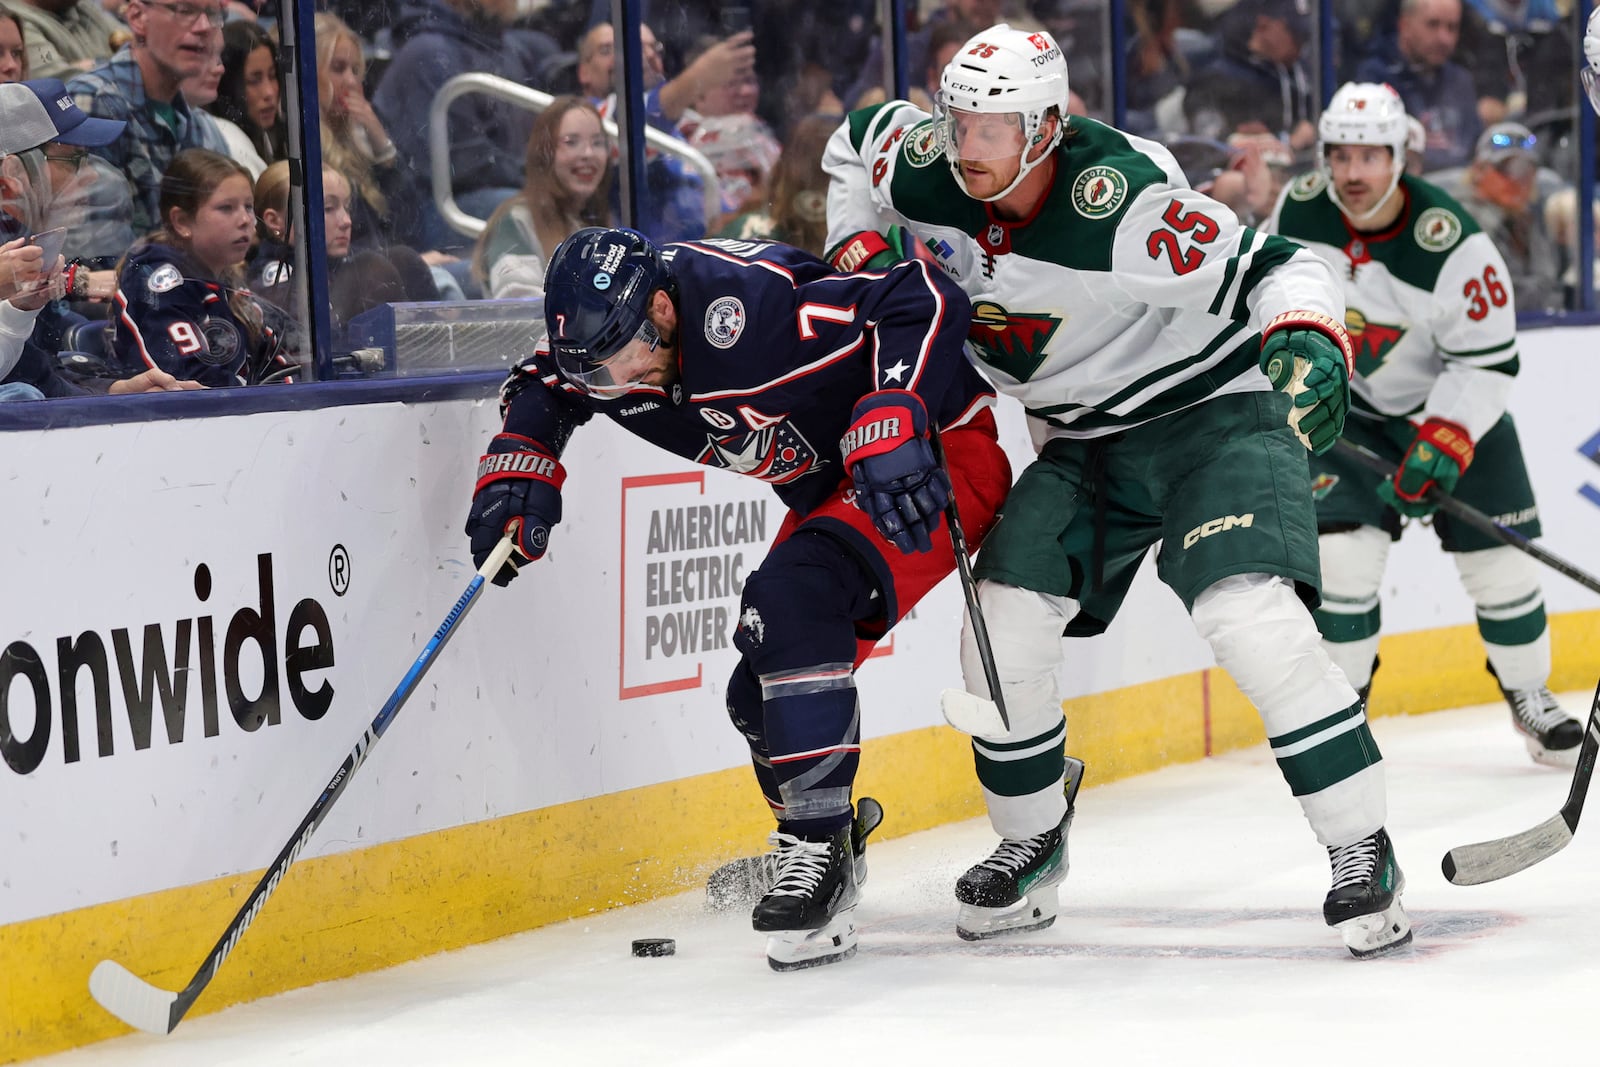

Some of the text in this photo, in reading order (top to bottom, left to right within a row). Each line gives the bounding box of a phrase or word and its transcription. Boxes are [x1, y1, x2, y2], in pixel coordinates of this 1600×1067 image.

[968, 43, 999, 58] 25
[1031, 45, 1060, 67] TOYOTA
[952, 82, 979, 93] CCM
[1105, 187, 1123, 210] WILD
[1146, 199, 1220, 275] 25
[600, 244, 618, 271] bread
[1464, 265, 1508, 321] 36
[557, 314, 566, 337] 7
[796, 302, 857, 341] 7
[167, 320, 202, 355] 9
[620, 400, 661, 417] Safelite
[482, 500, 503, 518] COVERT
[646, 500, 767, 555] AMERICAN
[1183, 513, 1254, 550] CCM
[646, 552, 744, 607] ELECTRIC
[645, 606, 729, 660] POWER
